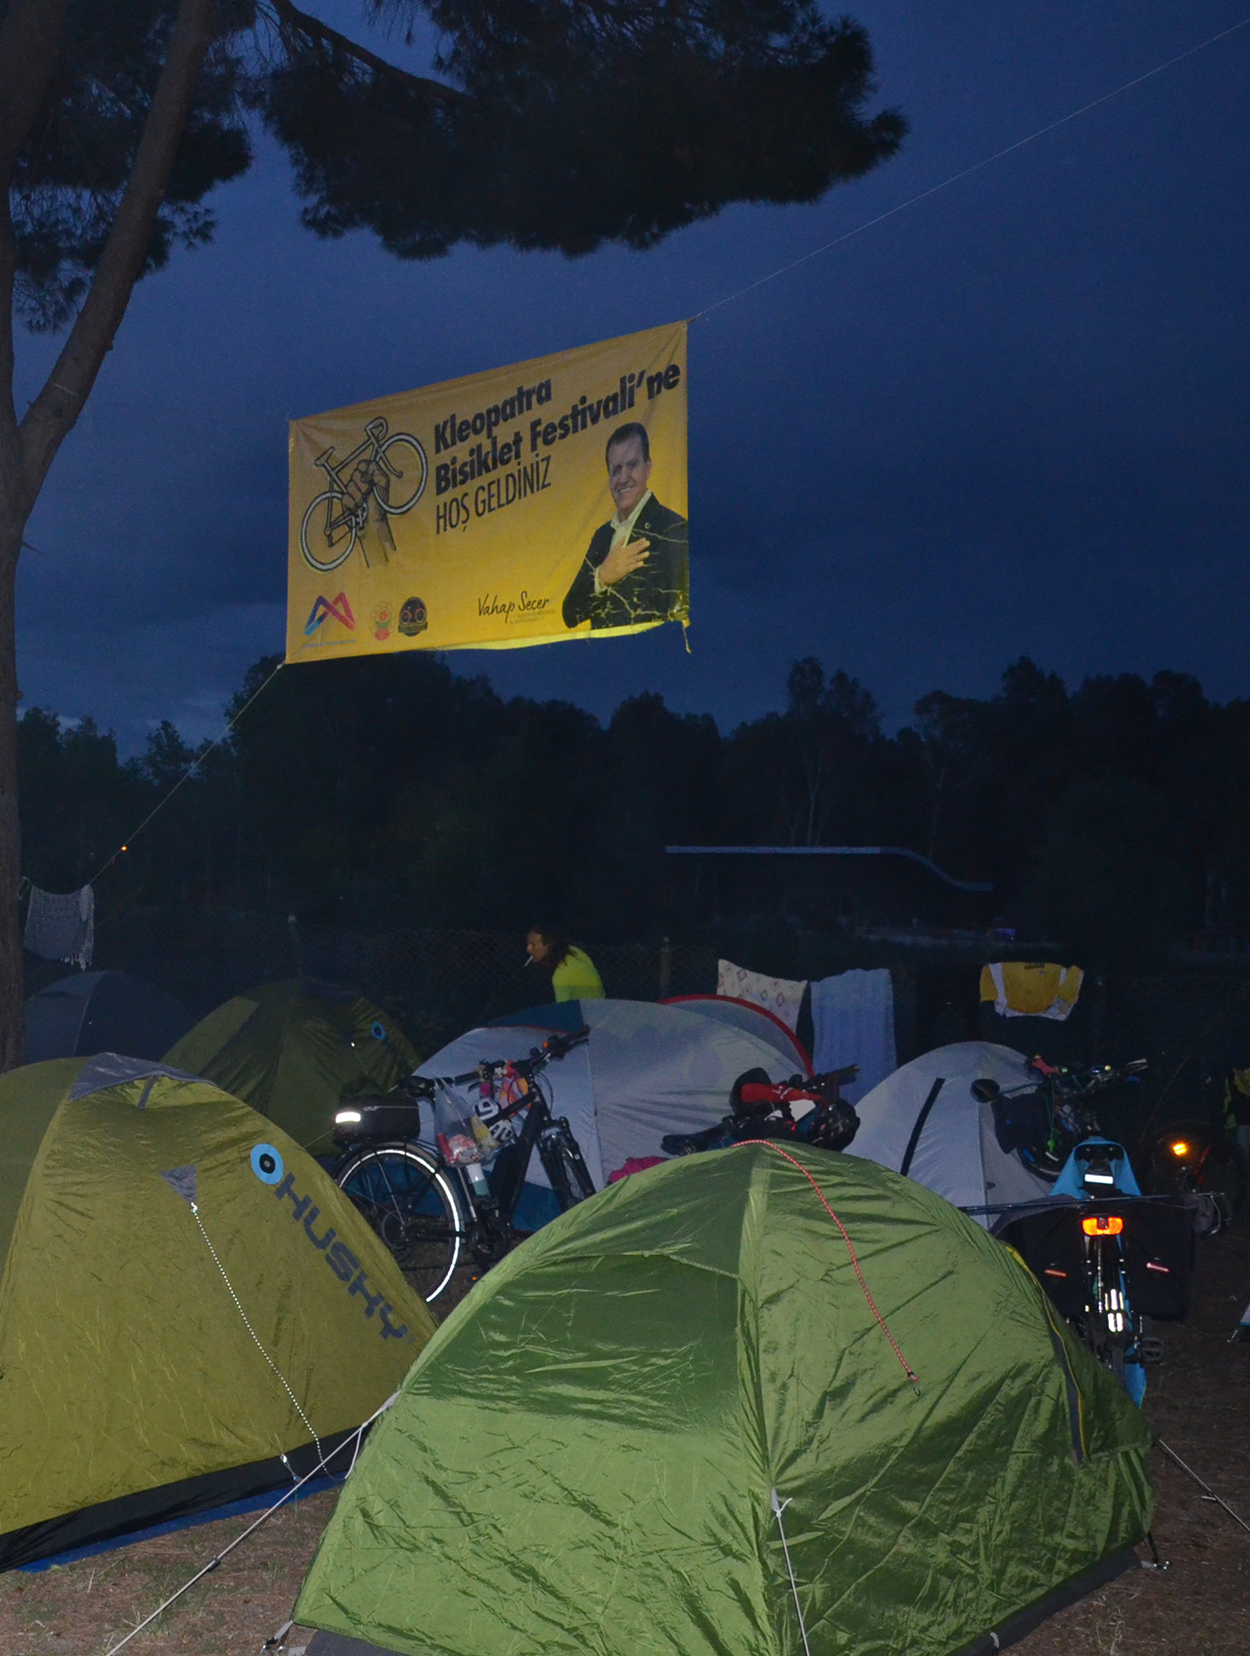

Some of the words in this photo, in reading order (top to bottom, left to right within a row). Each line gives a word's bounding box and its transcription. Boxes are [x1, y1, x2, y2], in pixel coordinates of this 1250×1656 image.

[434, 378, 552, 454] Kleopatra
[436, 430, 523, 496] Bisiklet
[530, 364, 681, 452] Festivali'ne
[436, 492, 470, 535] HOŞ
[474, 452, 552, 518] GELDİNİZ
[478, 593, 516, 624] Vahap
[274, 1172, 408, 1340] HUSKY
